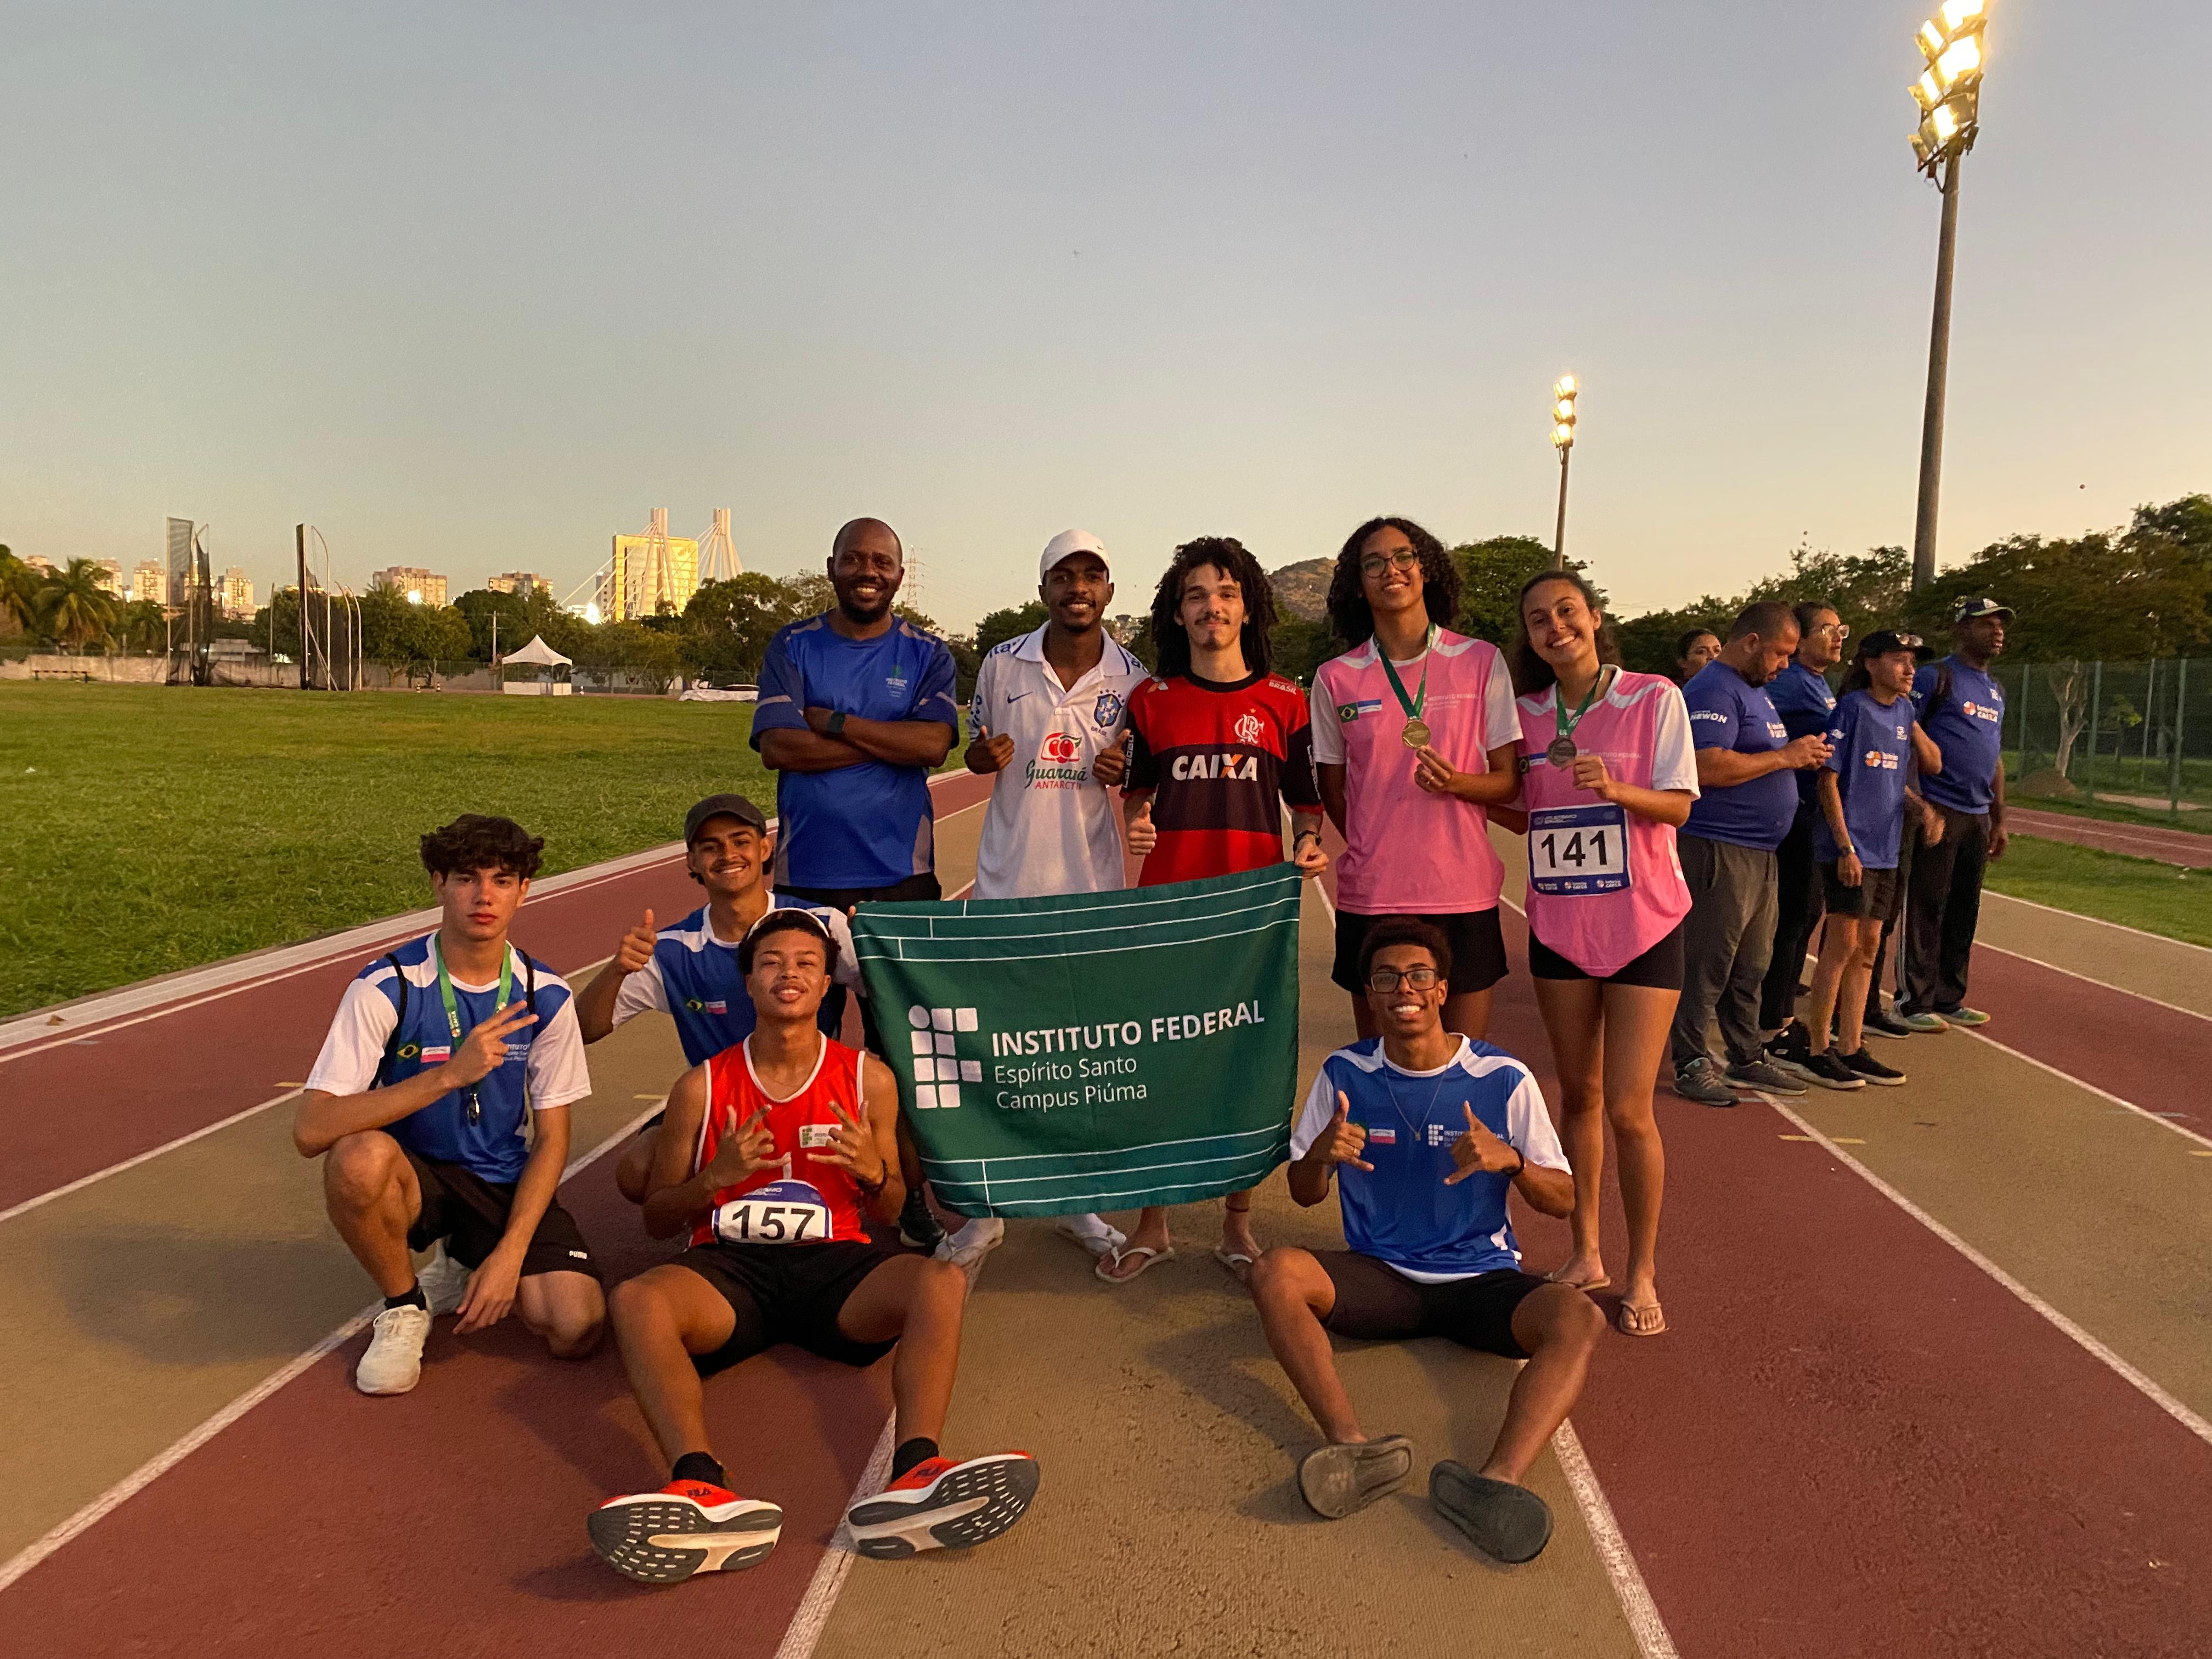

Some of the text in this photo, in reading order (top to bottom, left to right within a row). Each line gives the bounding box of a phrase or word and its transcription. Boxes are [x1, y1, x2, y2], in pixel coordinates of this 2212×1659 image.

[1268, 681, 1297, 695] BRASIL
[1172, 753, 1257, 782] CAIXA
[1541, 830, 1607, 868] 141
[992, 1000, 1265, 1057] INSTITUTO FEDERAL
[995, 1057, 1137, 1089] Espírito Santo
[996, 1082, 1147, 1113] Campus Piúma
[732, 1205, 816, 1240] 157
